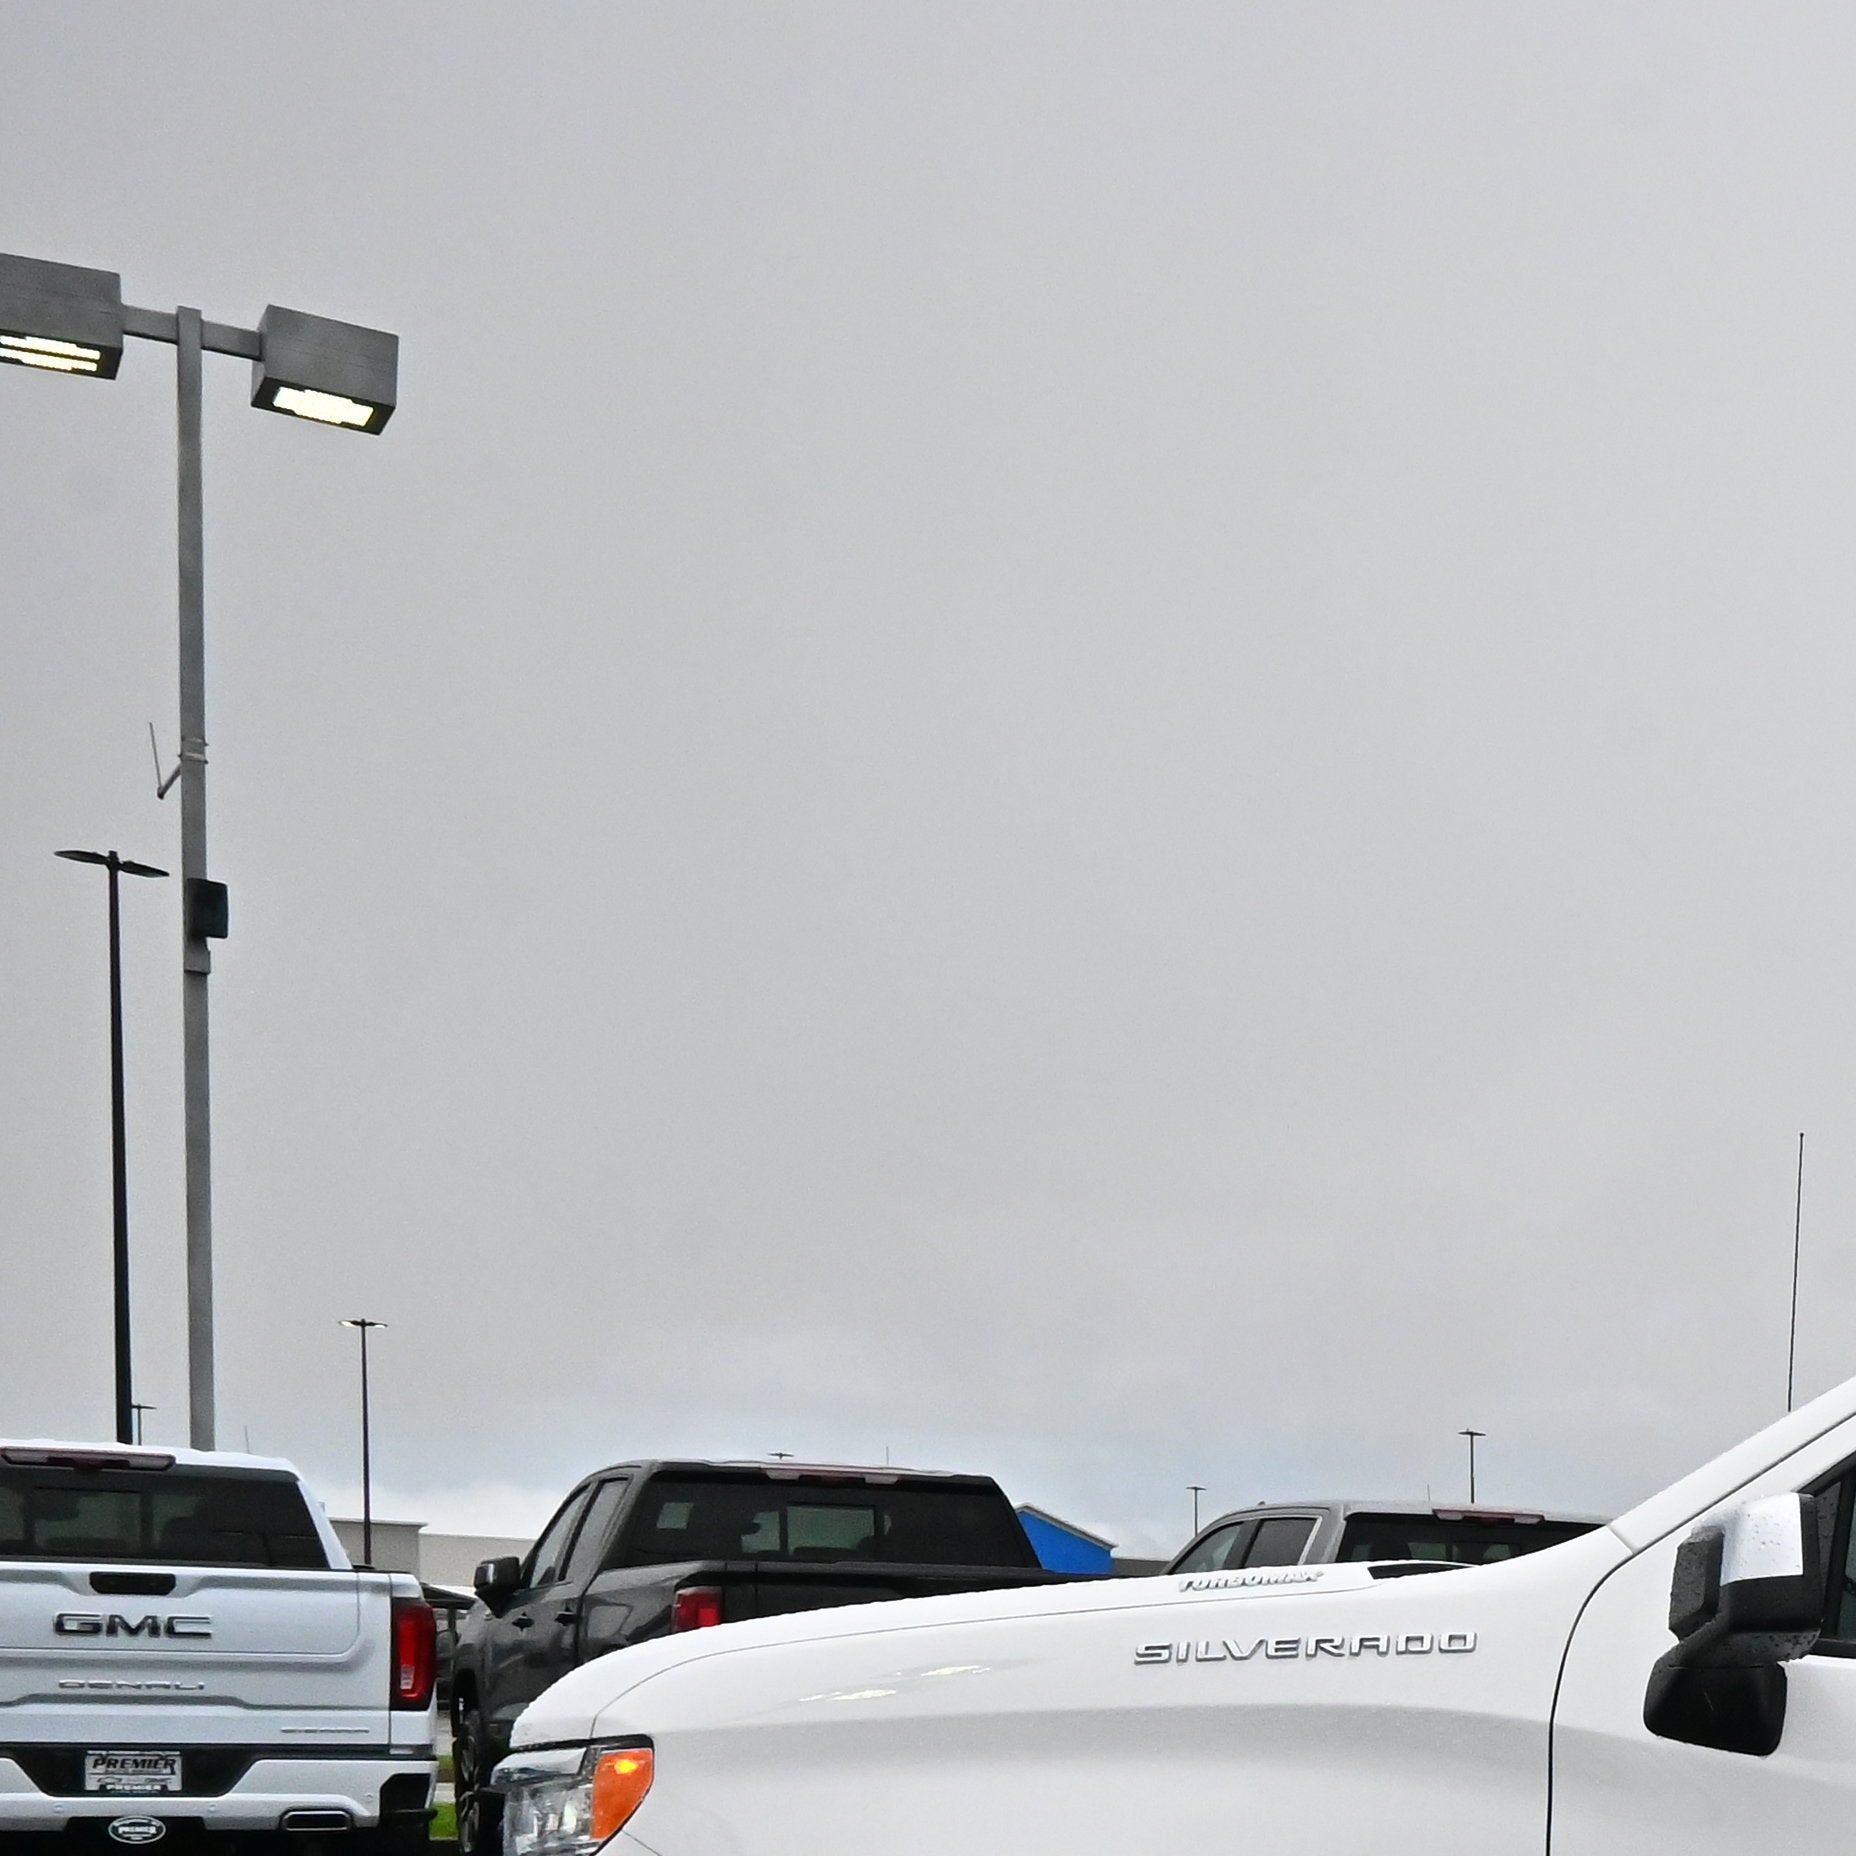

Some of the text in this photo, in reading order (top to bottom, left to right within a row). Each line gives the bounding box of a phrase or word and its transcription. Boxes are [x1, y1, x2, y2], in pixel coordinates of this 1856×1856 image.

[54, 1612, 213, 1640] GMC
[1133, 1630, 1479, 1666] SILVERADO
[92, 1758, 177, 1775] PREMIER
